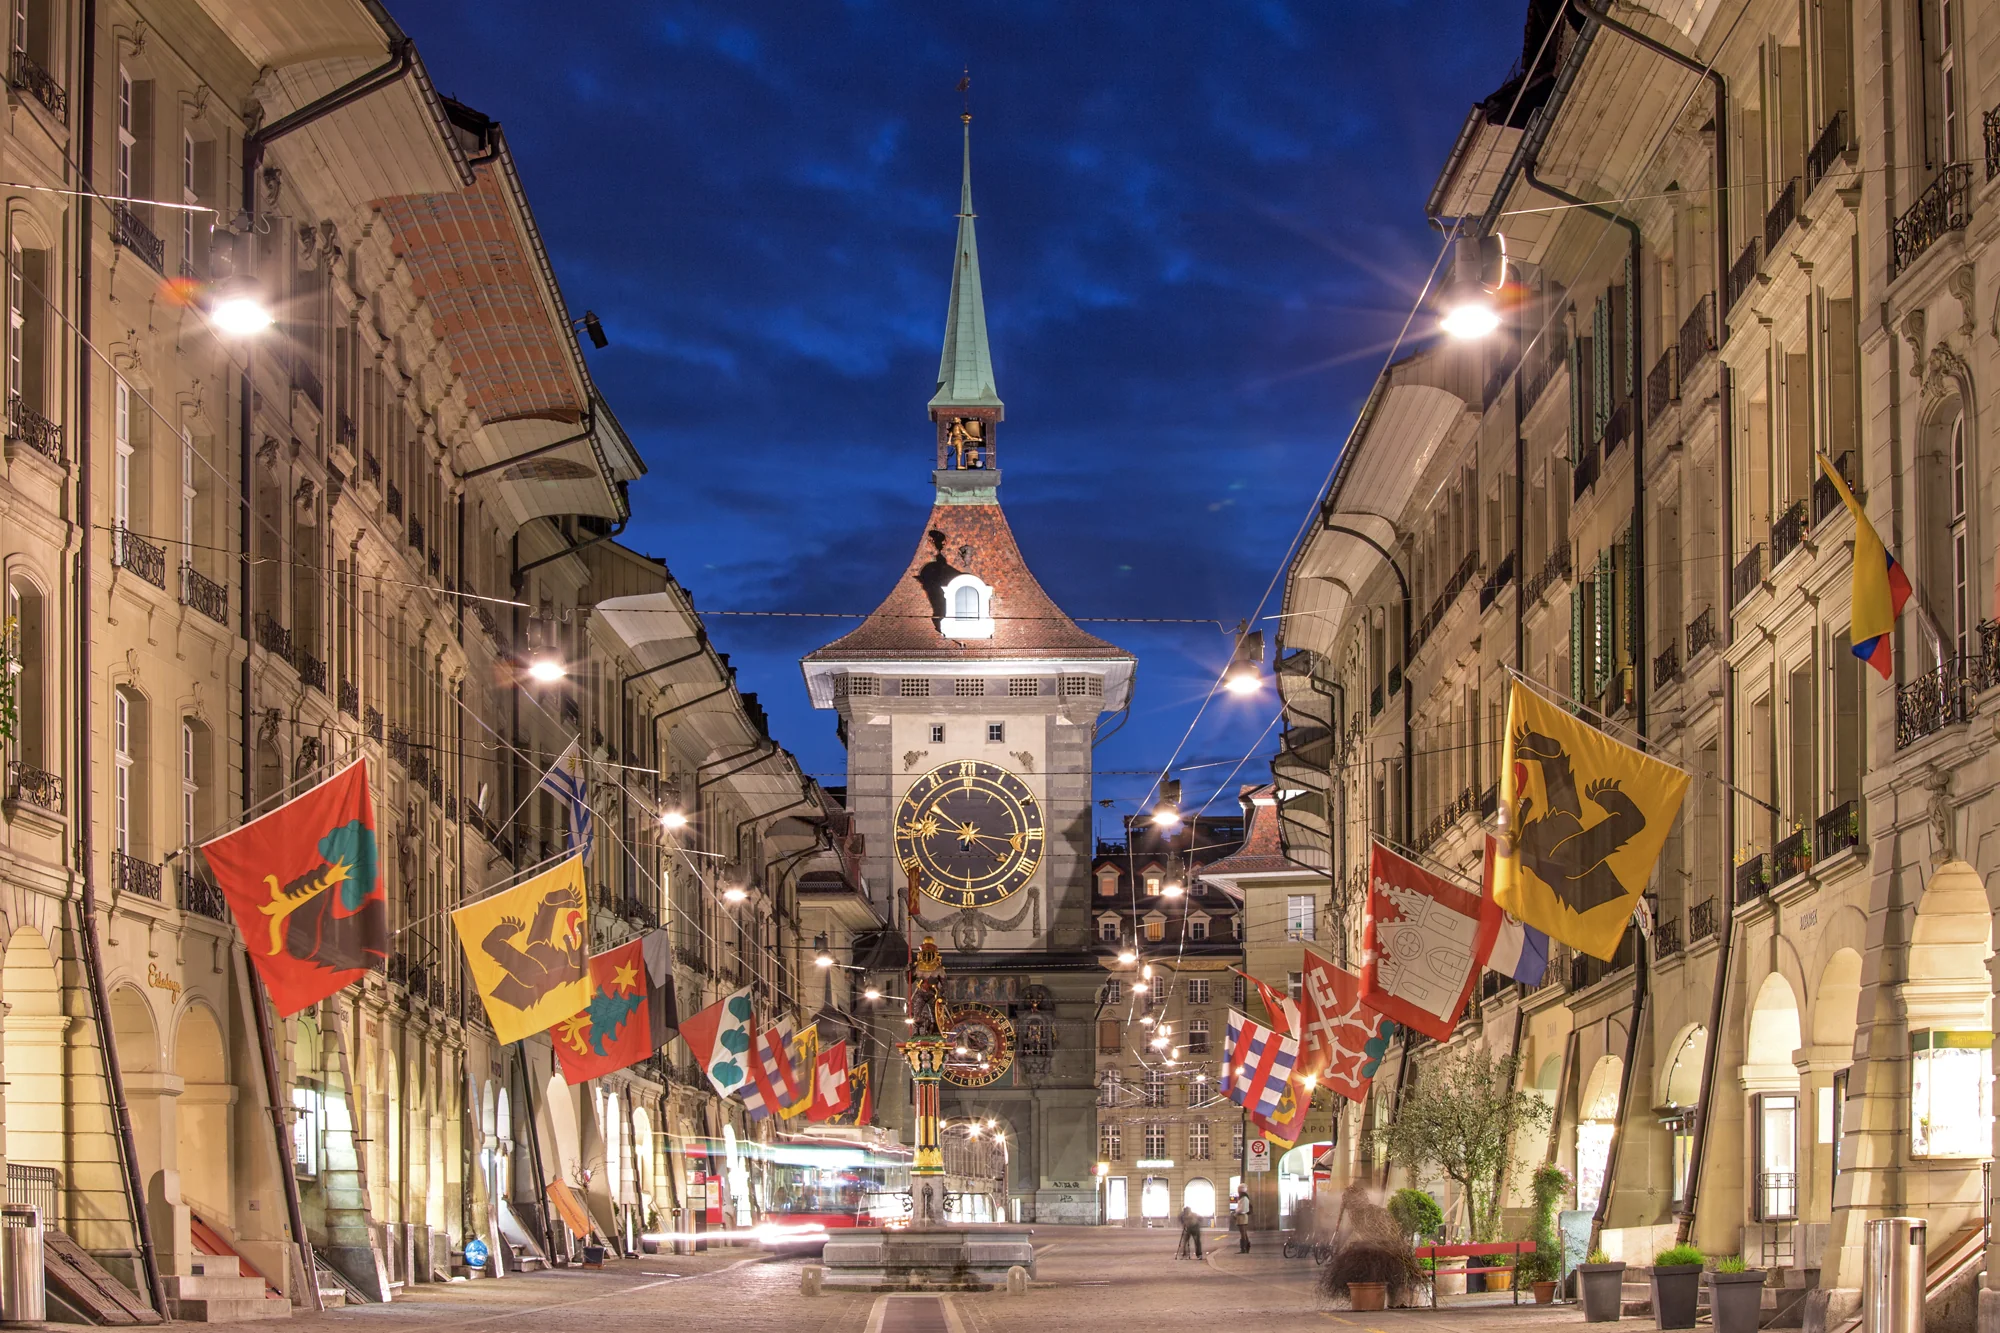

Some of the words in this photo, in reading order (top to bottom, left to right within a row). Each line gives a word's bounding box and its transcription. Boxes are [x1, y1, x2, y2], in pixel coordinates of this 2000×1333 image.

[959, 763, 976, 776] XII
[928, 771, 943, 788] XI
[997, 771, 1010, 785] I
[906, 797, 919, 809] X
[1028, 827, 1042, 840] III
